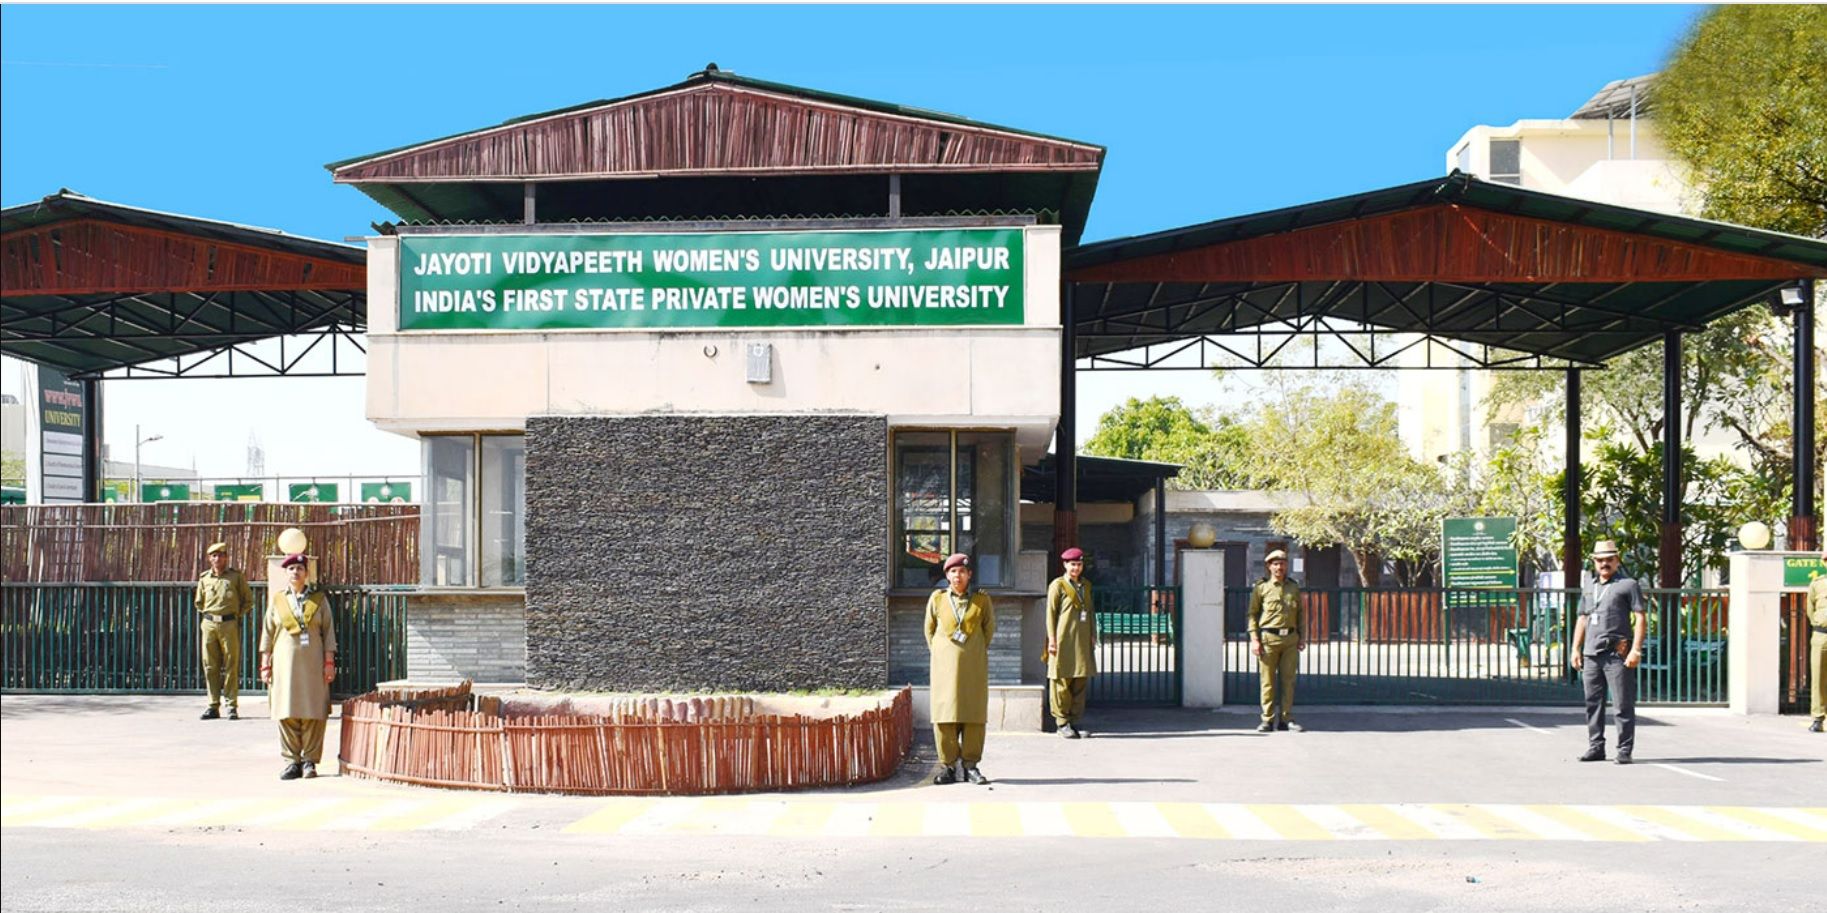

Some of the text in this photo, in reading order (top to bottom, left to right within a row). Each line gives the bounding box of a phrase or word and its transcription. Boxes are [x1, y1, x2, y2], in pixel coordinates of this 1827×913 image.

[414, 246, 1009, 275] JAYOTI VIDYAPEETH WOMEN'S UNIVERSITY, JAIPUR
[415, 284, 1009, 314] INDIA'S FIRST STATE PRIVATE WOMEN'S UNIVERSITY
[44, 409, 81, 427] UNIVERSITY
[1787, 558, 1817, 568] GATE
